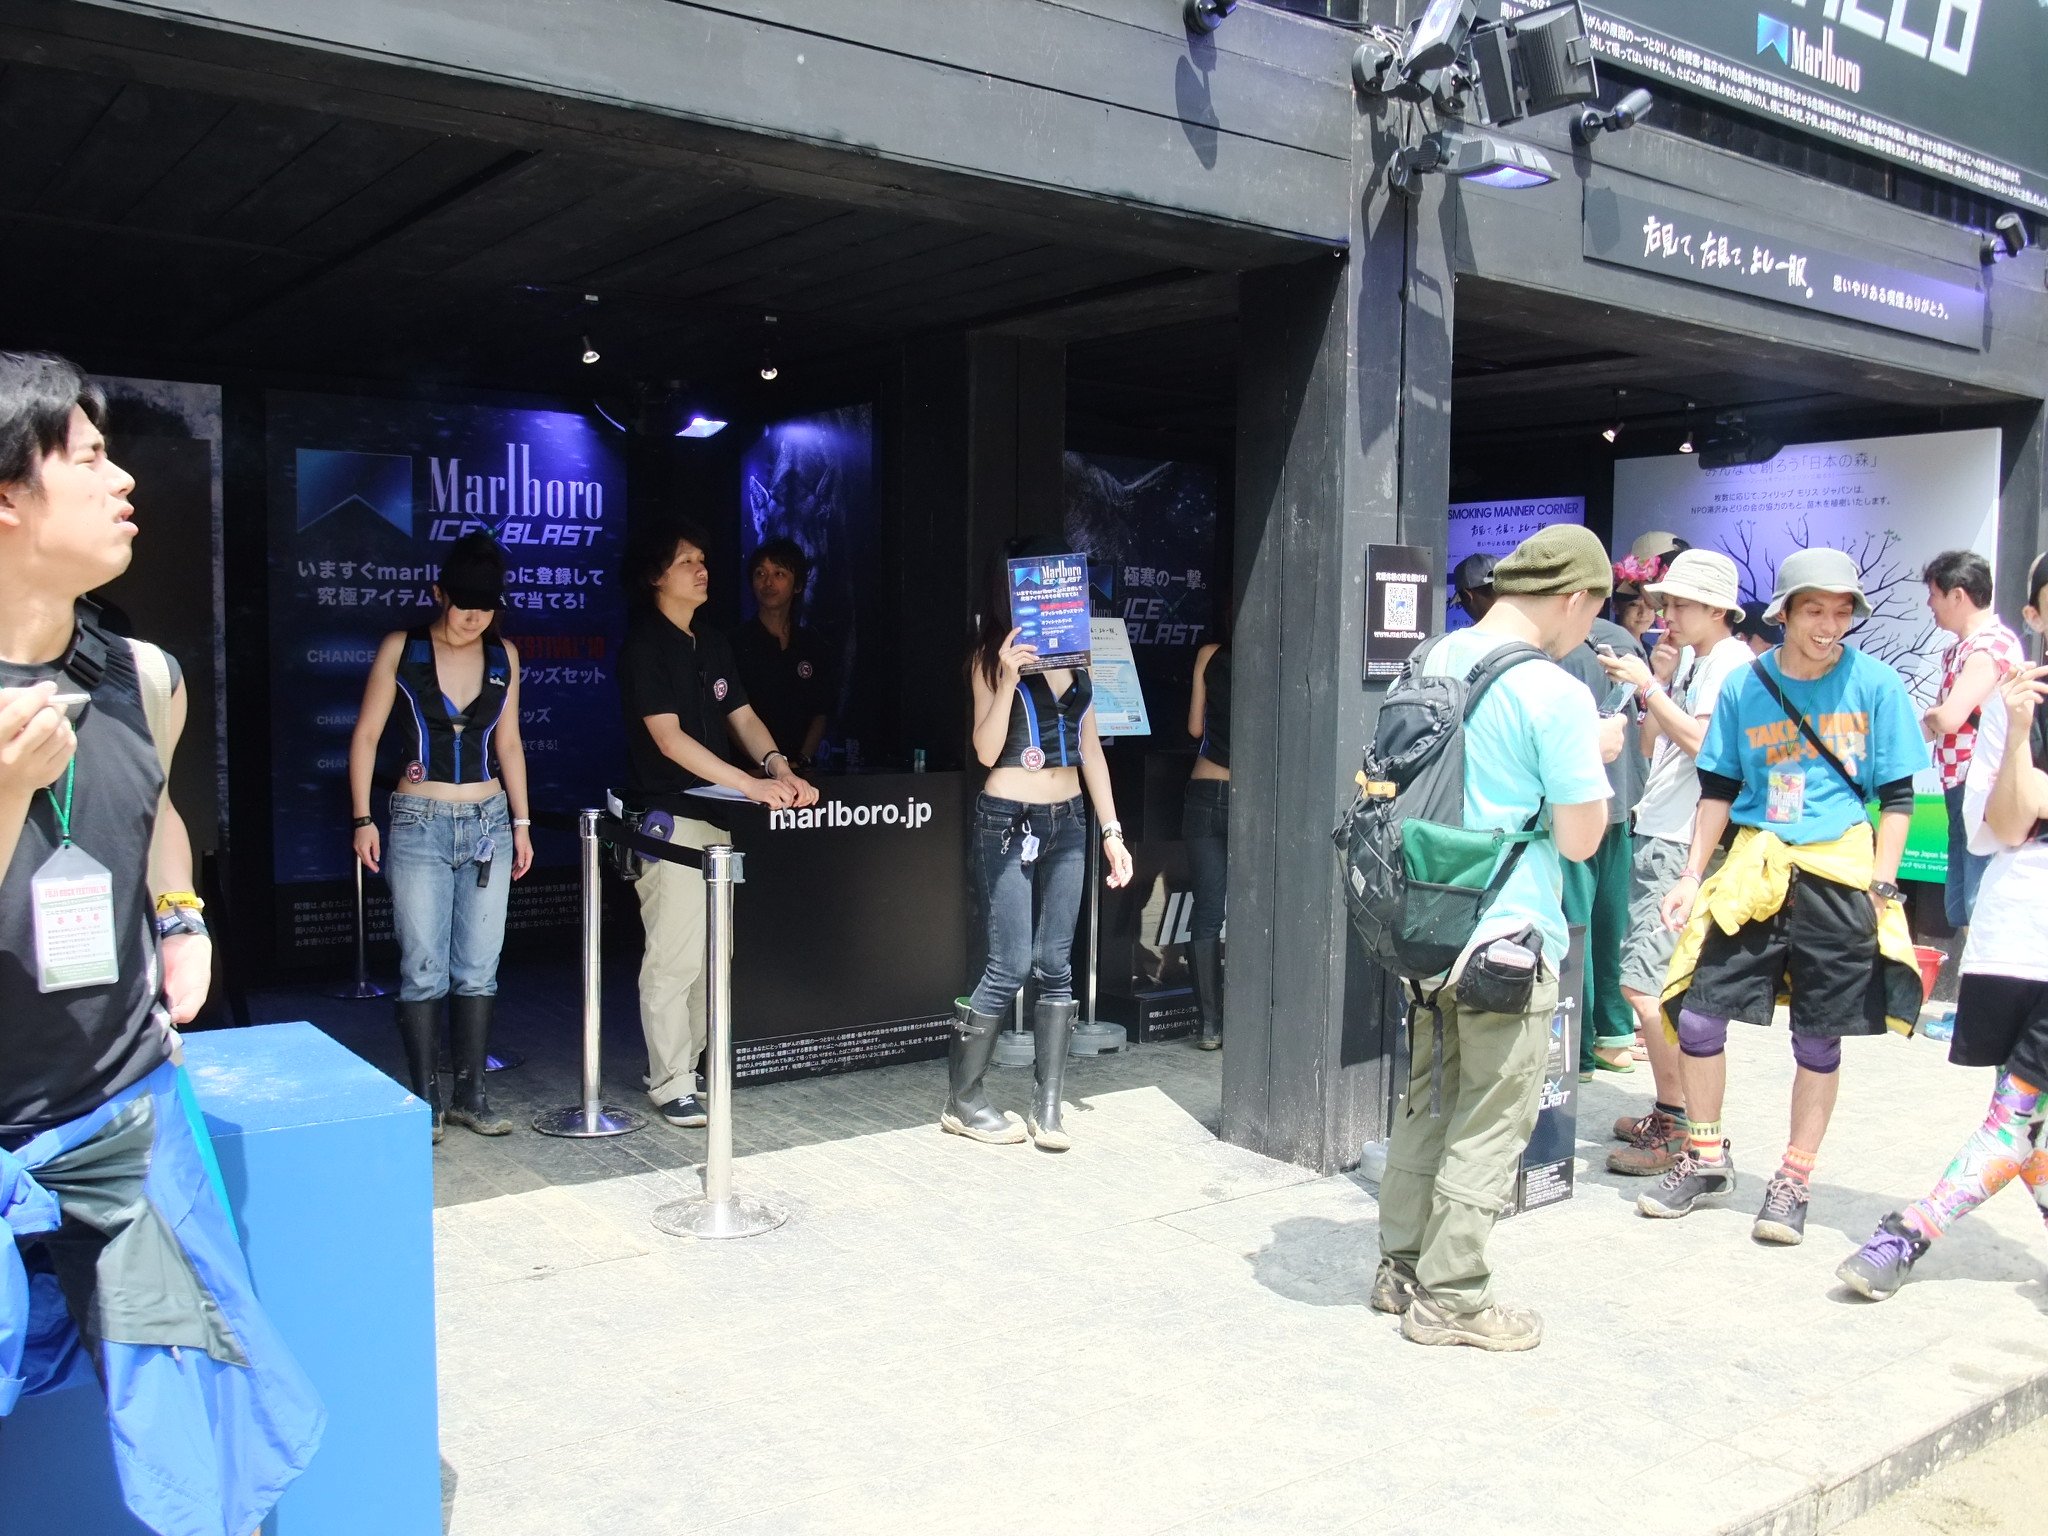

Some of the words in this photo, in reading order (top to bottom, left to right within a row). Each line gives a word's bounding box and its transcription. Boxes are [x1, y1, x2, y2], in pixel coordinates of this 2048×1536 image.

[1791, 25, 1860, 94] Marlboro
[428, 442, 603, 520] Marlboro
[1447, 507, 1492, 520] SMOKING
[1494, 505, 1535, 518] MANNER
[1537, 502, 1579, 515] CORNER
[501, 522, 603, 546] BLAST
[1041, 560, 1082, 580] Marlboro
[1058, 575, 1082, 584] BLAST
[1123, 565, 1207, 590] 極寒の一撃。
[1122, 597, 1164, 620] ICE
[1126, 622, 1205, 645] BLAST
[1374, 631, 1426, 641] www.marlboro.jp
[769, 797, 932, 830] marlboro.jp
